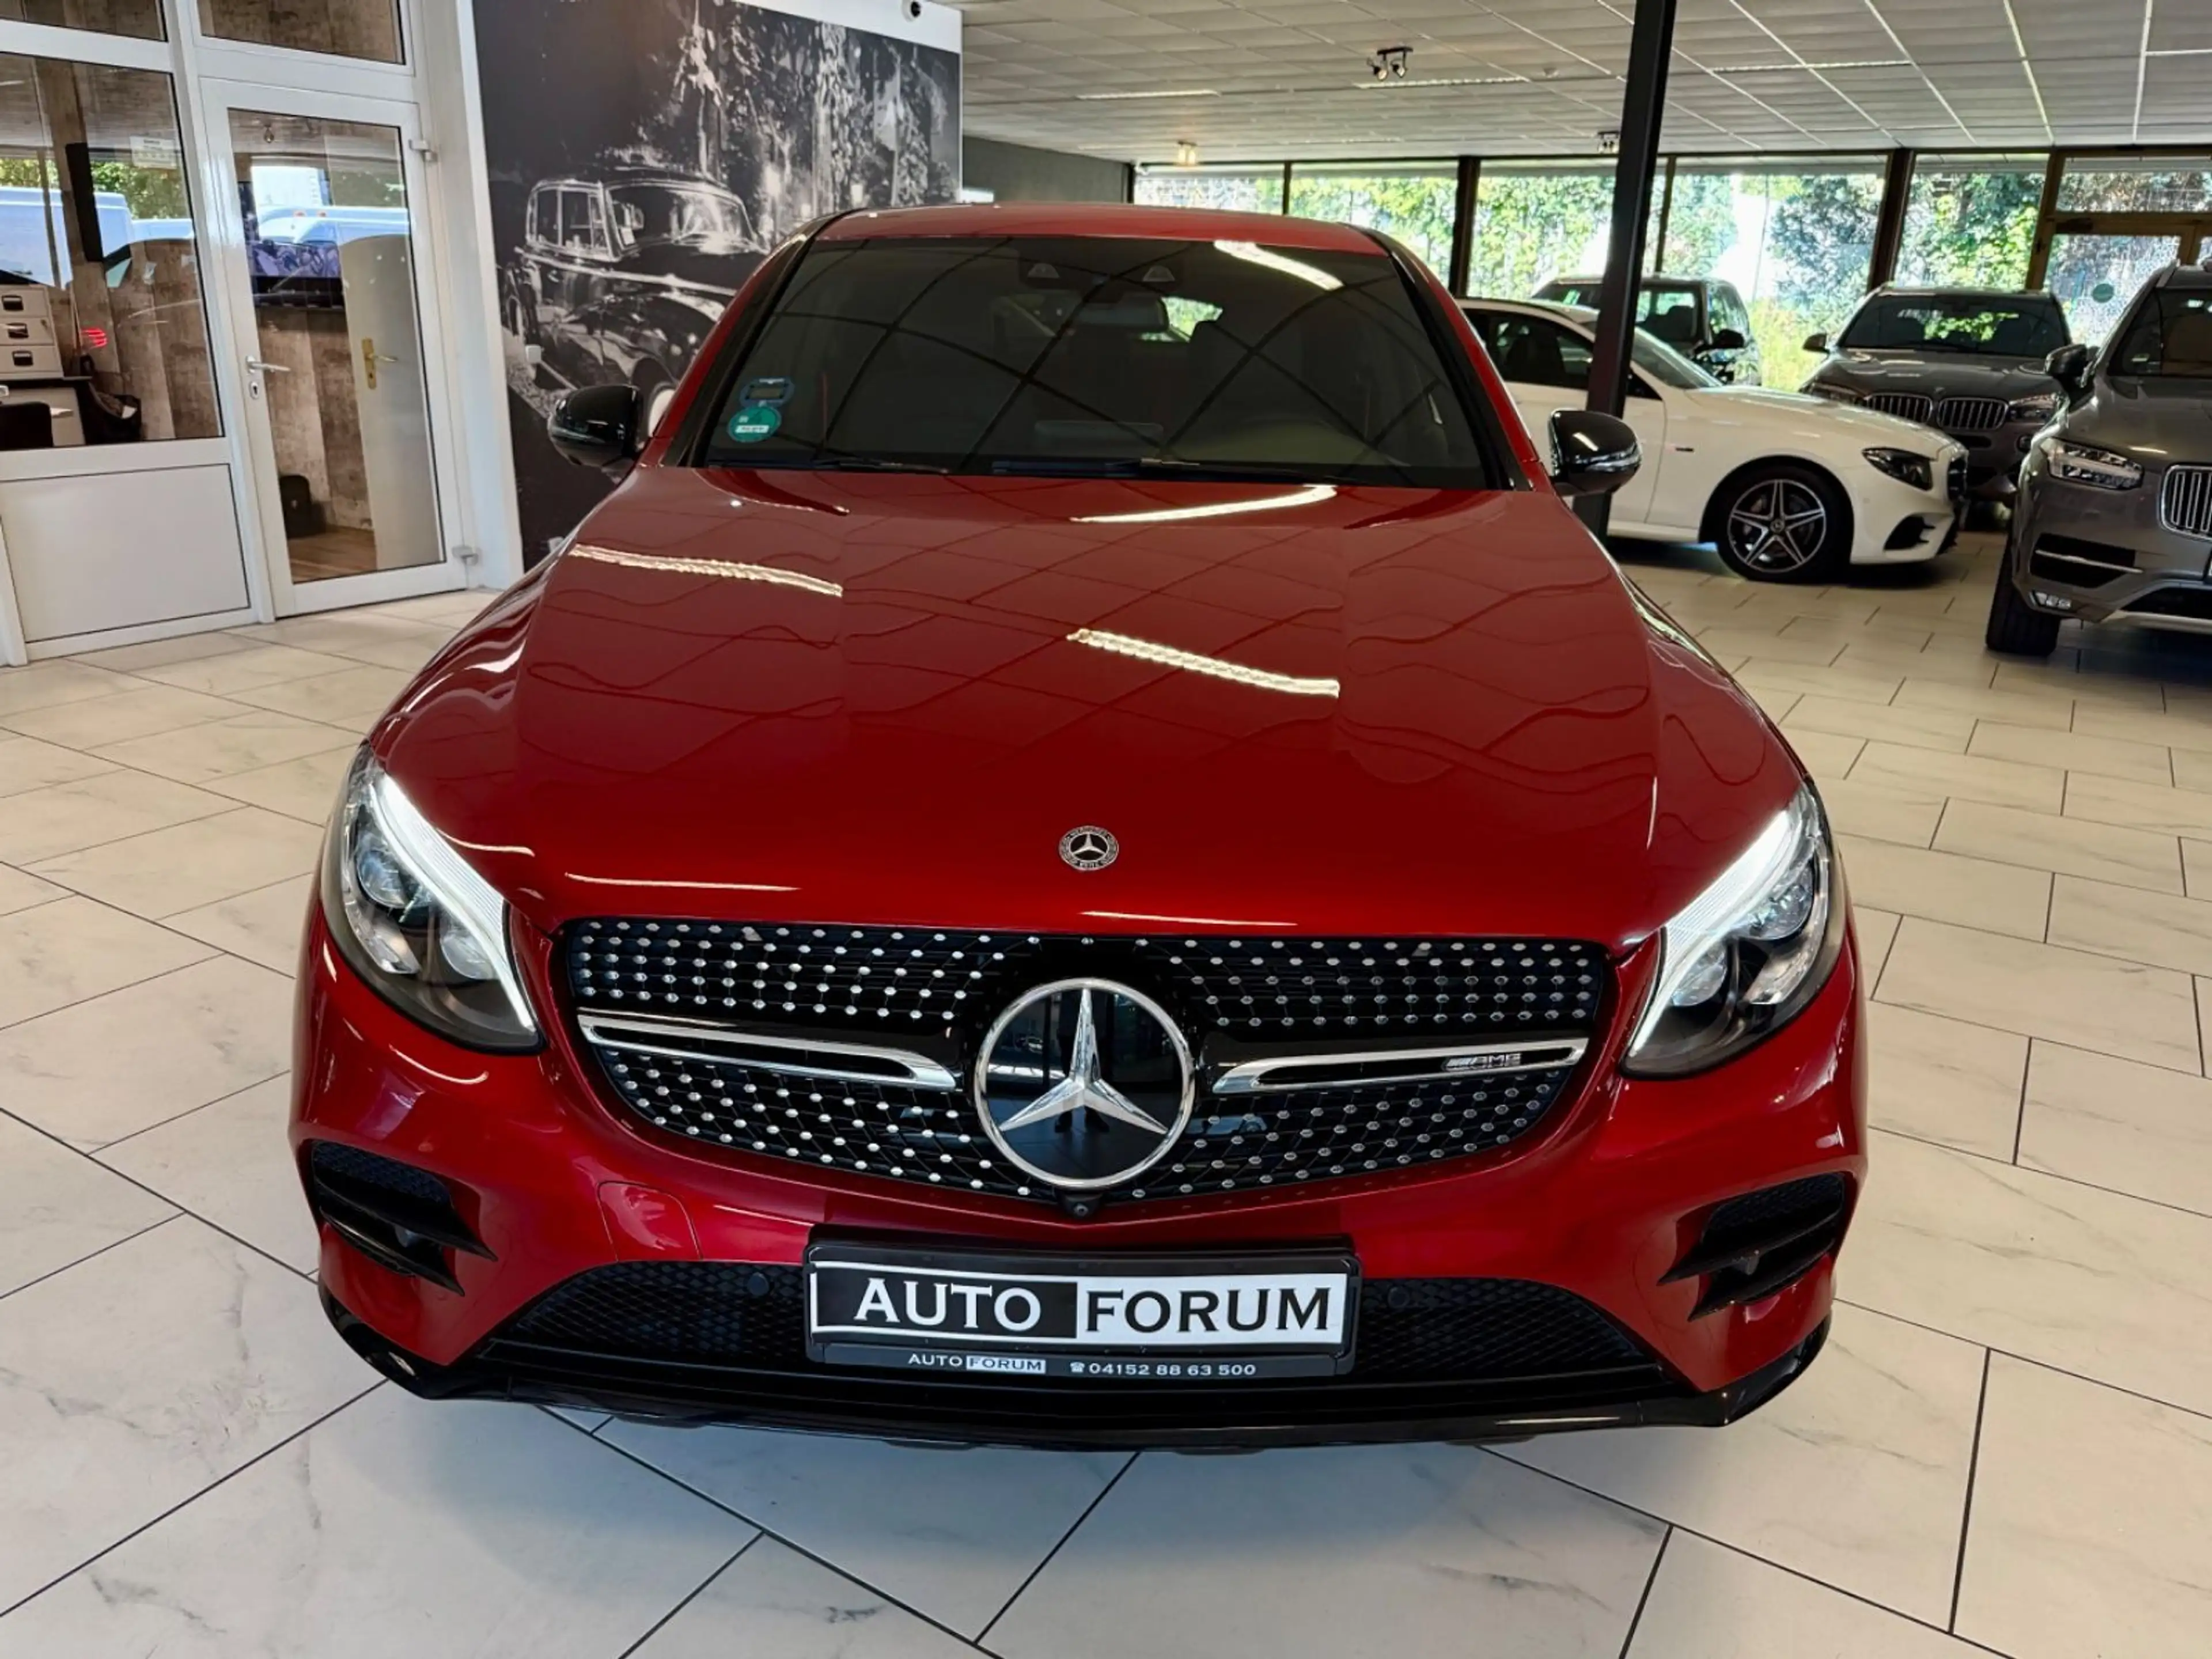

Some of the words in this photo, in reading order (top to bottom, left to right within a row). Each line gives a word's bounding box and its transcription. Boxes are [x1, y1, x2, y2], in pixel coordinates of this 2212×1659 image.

[854, 1278, 1041, 1331] AUTO
[1086, 1287, 1331, 1333] FORUM
[908, 1353, 963, 1367] AUTO
[970, 1357, 1042, 1371] FORUM
[1089, 1362, 1150, 1376] 04152
[1156, 1363, 1181, 1376] 88
[1187, 1363, 1212, 1376] 63
[1218, 1363, 1256, 1376] 500
